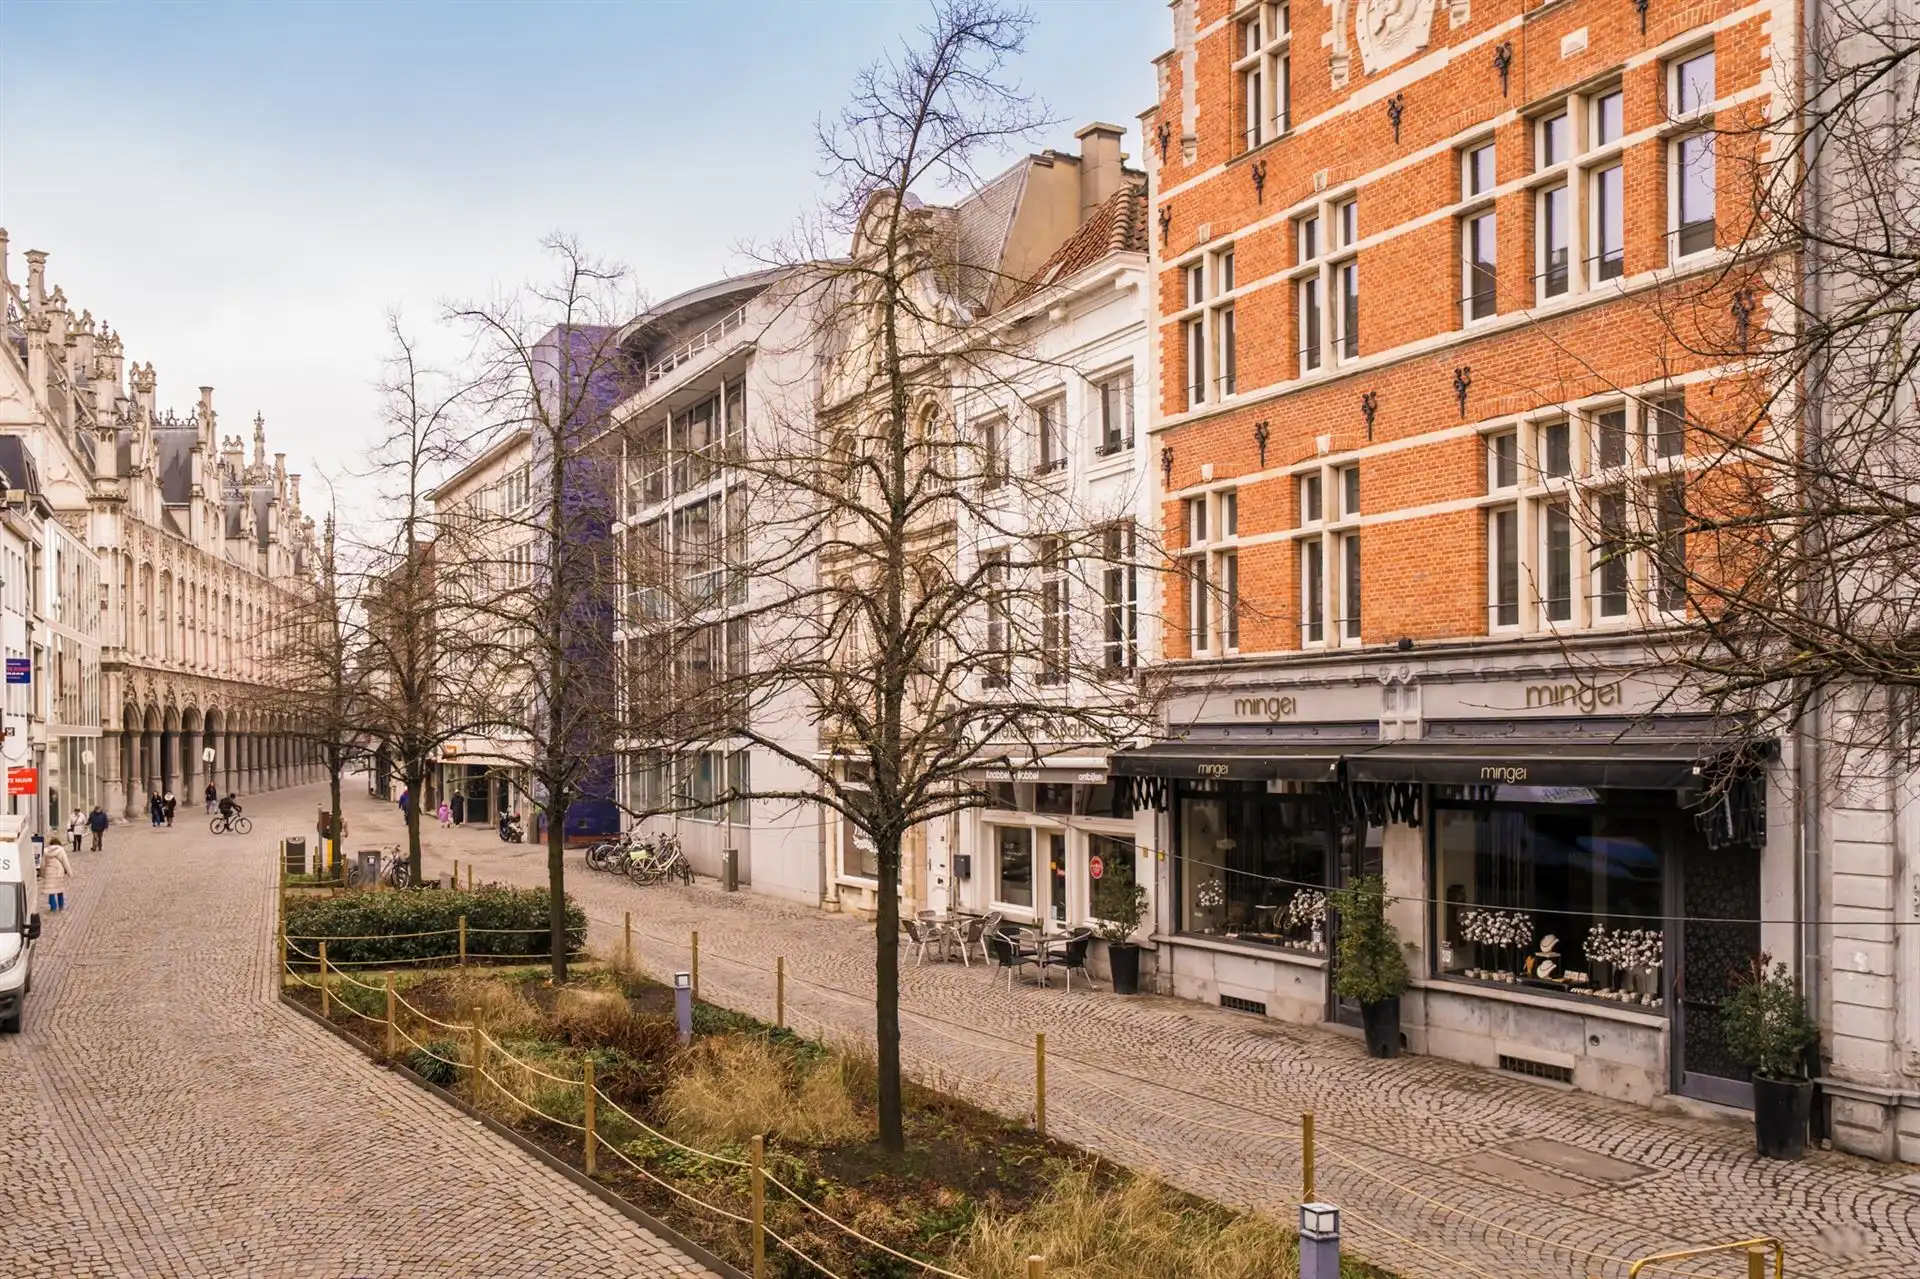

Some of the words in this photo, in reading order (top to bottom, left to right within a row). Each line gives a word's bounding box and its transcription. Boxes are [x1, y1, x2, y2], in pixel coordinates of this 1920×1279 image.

[1525, 682, 1621, 713] mingei
[1234, 696, 1296, 722] mingei
[1197, 763, 1229, 778] mingei
[1480, 766, 1527, 783] mingei
[0, 858, 11, 871] S
